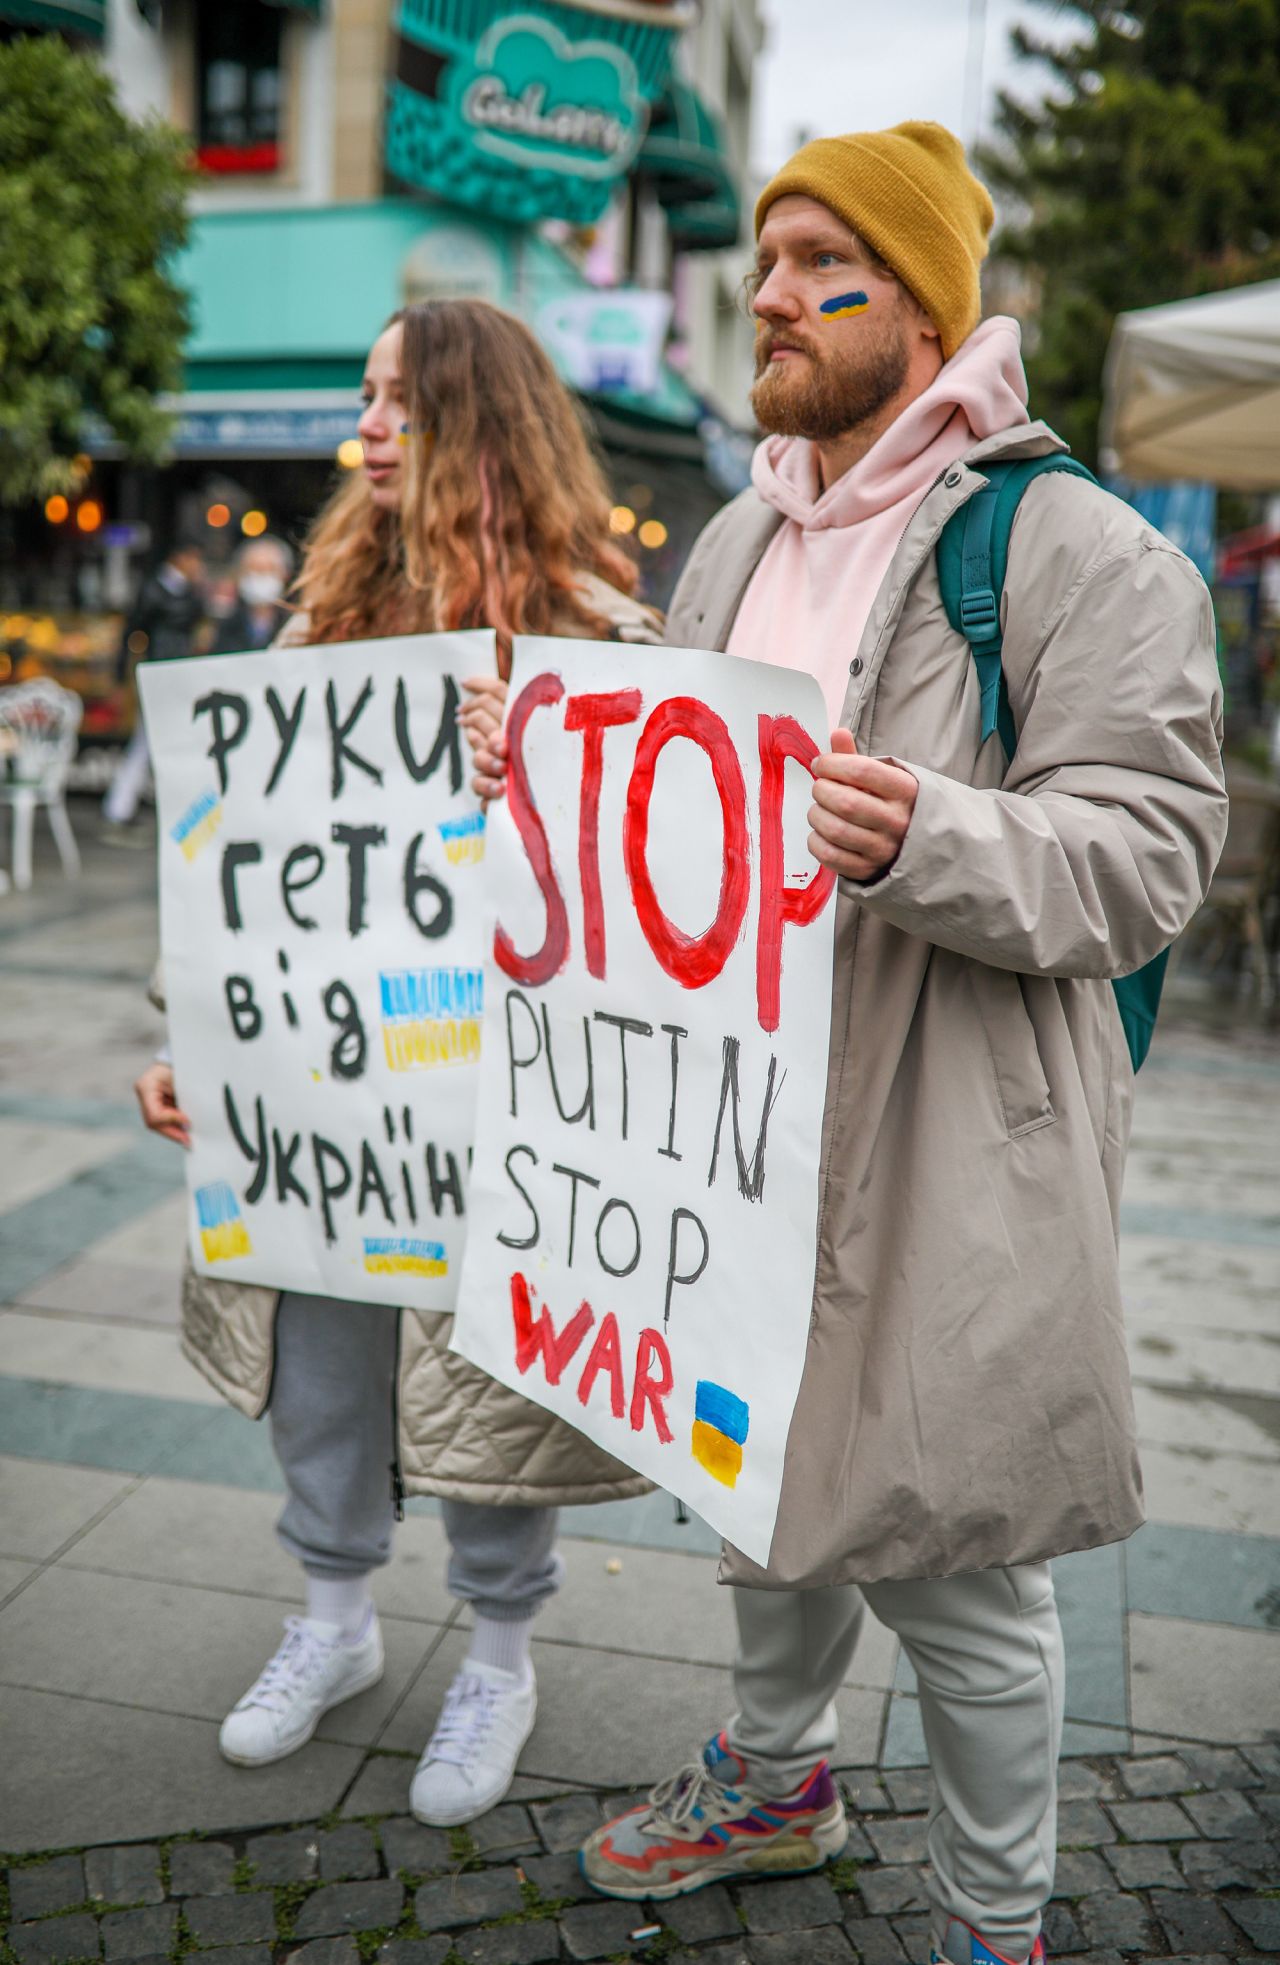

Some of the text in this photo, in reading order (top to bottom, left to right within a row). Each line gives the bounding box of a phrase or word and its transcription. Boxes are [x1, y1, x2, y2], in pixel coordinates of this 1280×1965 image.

[193, 674, 463, 799] РУКИ
[493, 672, 839, 1033] STOP
[505, 989, 787, 1204] PUTIN
[496, 1144, 709, 1325] STOP
[510, 1271, 675, 1445] WAR
